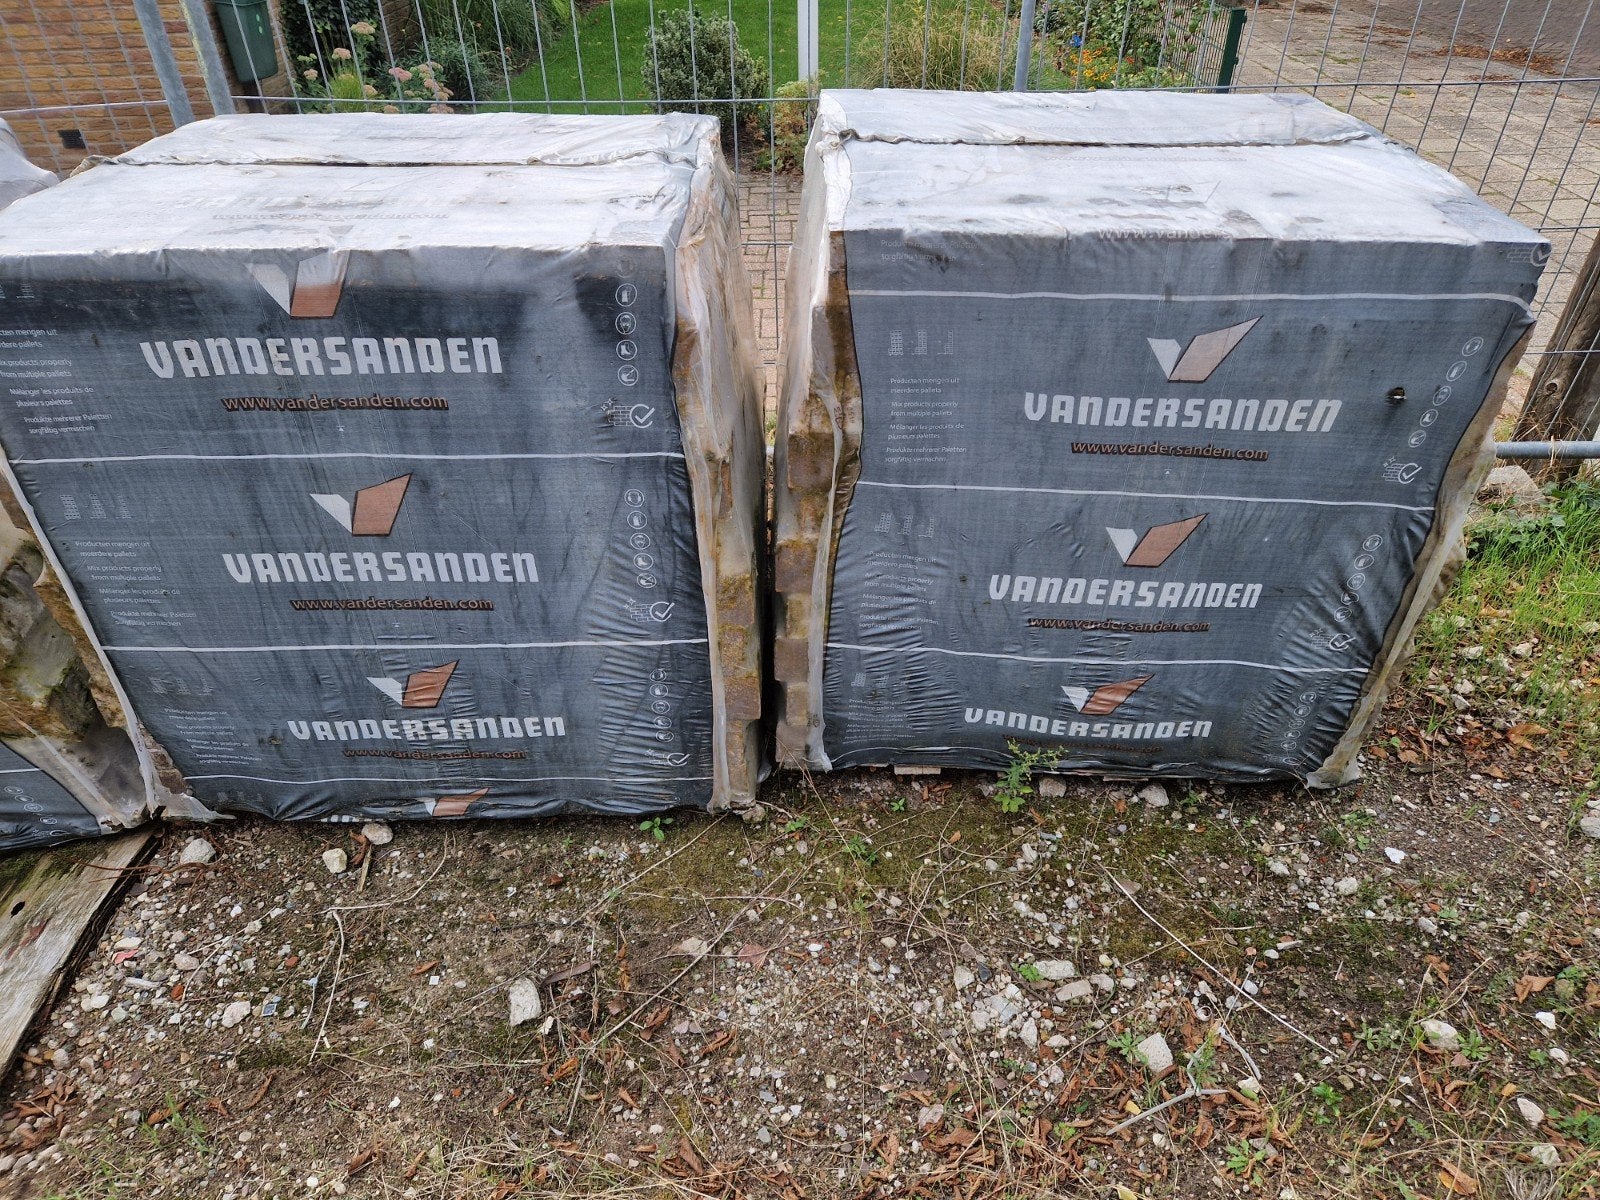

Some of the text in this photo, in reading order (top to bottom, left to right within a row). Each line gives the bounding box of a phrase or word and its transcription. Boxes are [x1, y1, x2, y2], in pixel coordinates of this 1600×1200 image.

[139, 336, 503, 379] VANDERSANDEN
[222, 393, 449, 412] www.vandersanden.com
[1024, 392, 1342, 432] VANDERSANDEN
[1071, 440, 1269, 461] www.vandersanden.com
[222, 552, 539, 583] VANDERSANDEN
[291, 595, 494, 611] www.vandersanden.com
[989, 574, 1263, 609] VANDERSANDEN
[287, 716, 566, 741] VANDERSANDEN
[964, 707, 1213, 739] VANDERSANDEN
